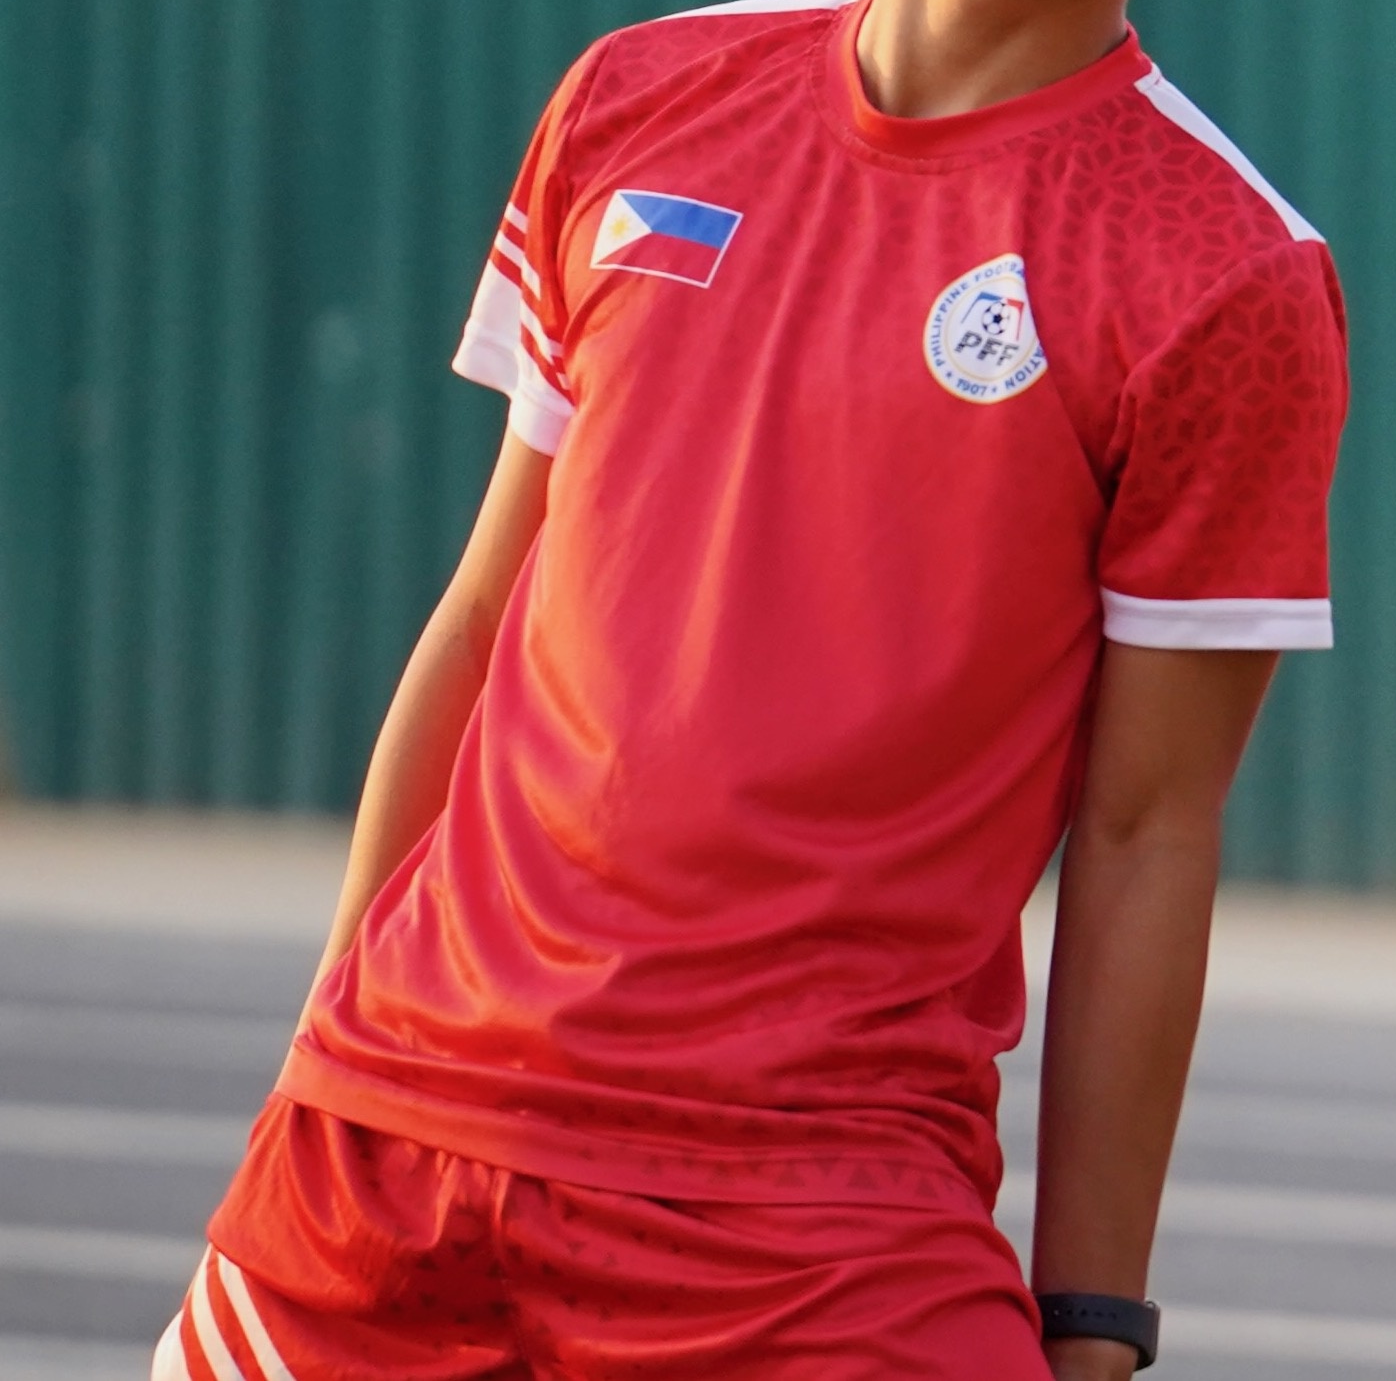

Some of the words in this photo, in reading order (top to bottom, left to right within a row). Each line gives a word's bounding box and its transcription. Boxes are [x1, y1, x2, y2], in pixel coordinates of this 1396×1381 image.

[930, 281, 969, 368] PHILIPPINE
[954, 330, 1020, 367] PFF
[956, 378, 988, 398] 1907
